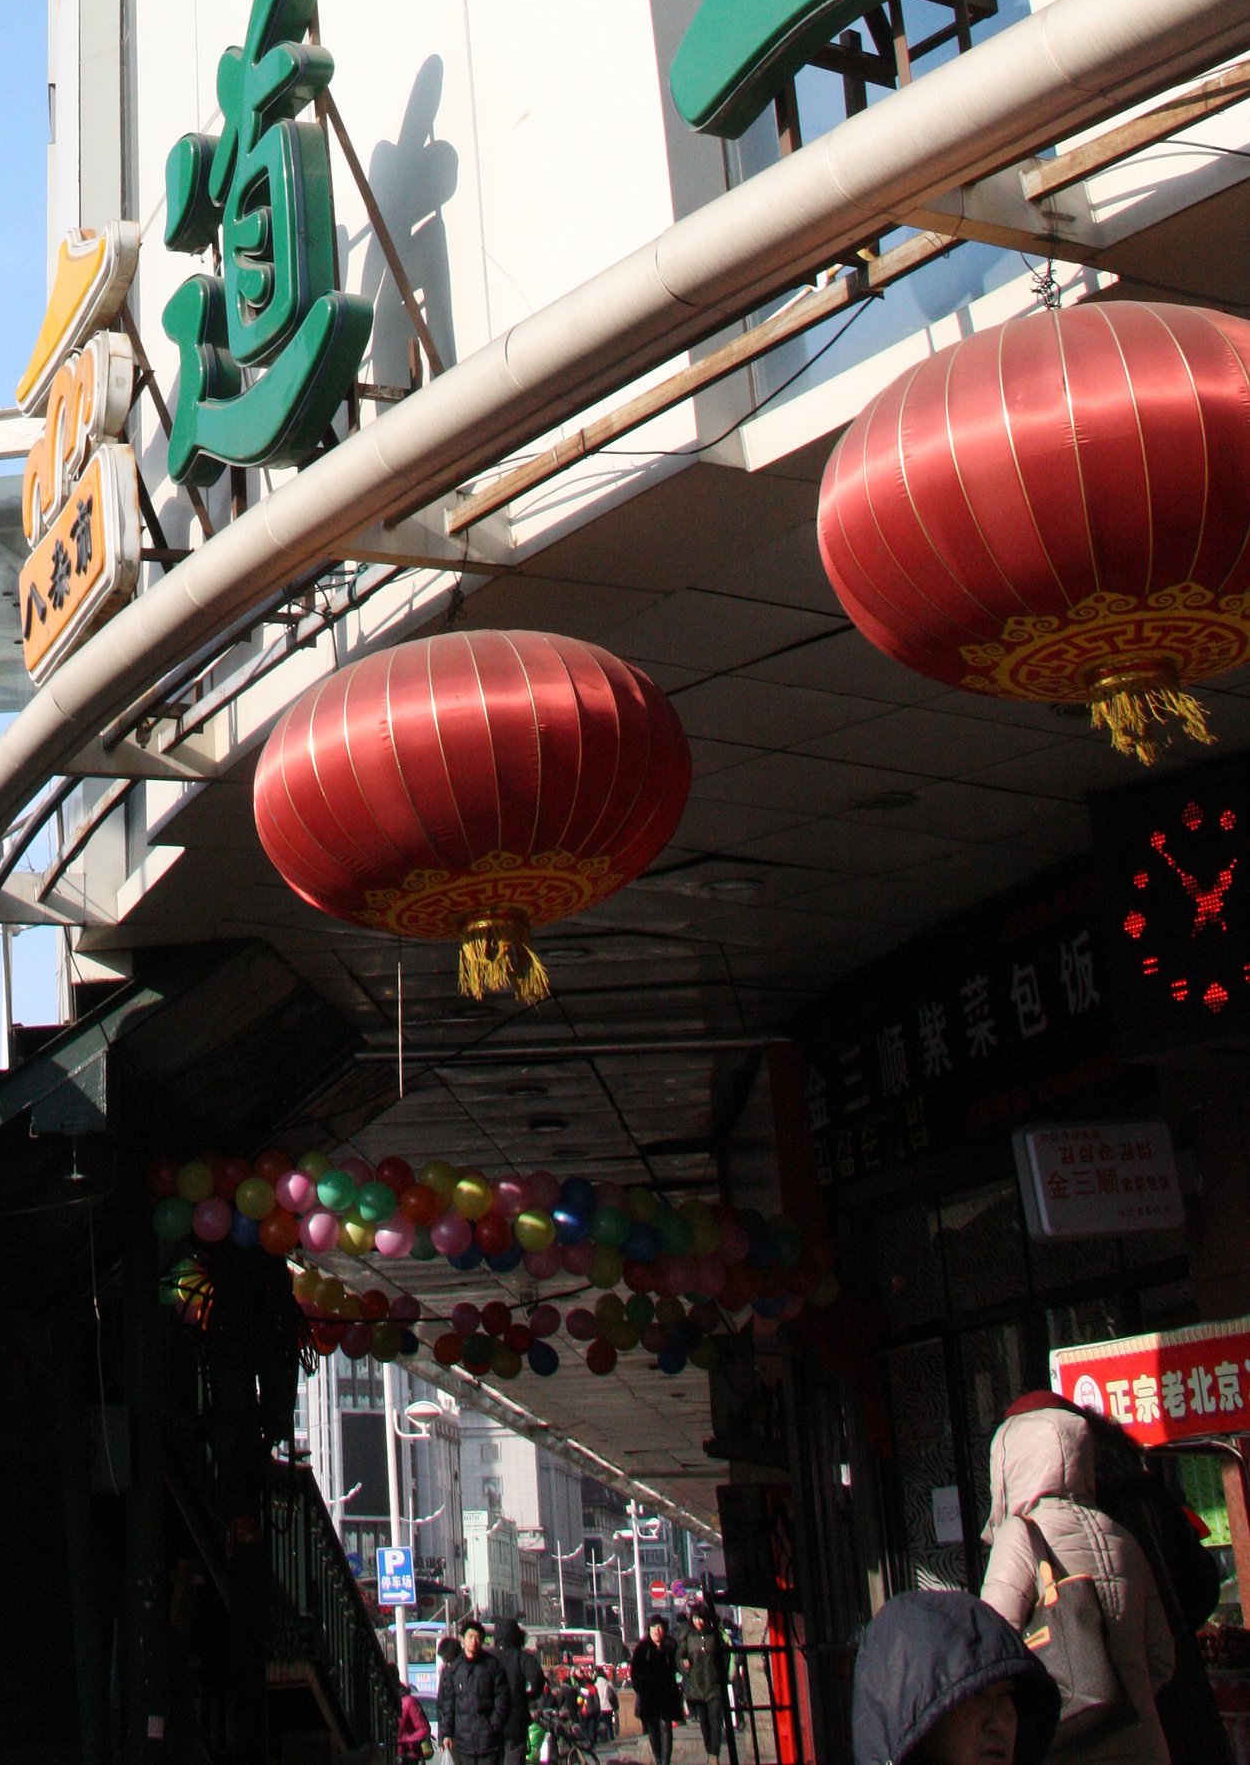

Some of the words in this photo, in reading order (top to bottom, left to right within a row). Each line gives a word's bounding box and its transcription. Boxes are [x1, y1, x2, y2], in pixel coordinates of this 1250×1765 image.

[803, 929, 1102, 1131] 金三顺紫菜包饭
[1106, 1358, 1250, 1424] 正宗老北京
[381, 1575, 412, 1590] 停车场
[384, 1549, 405, 1576] P
